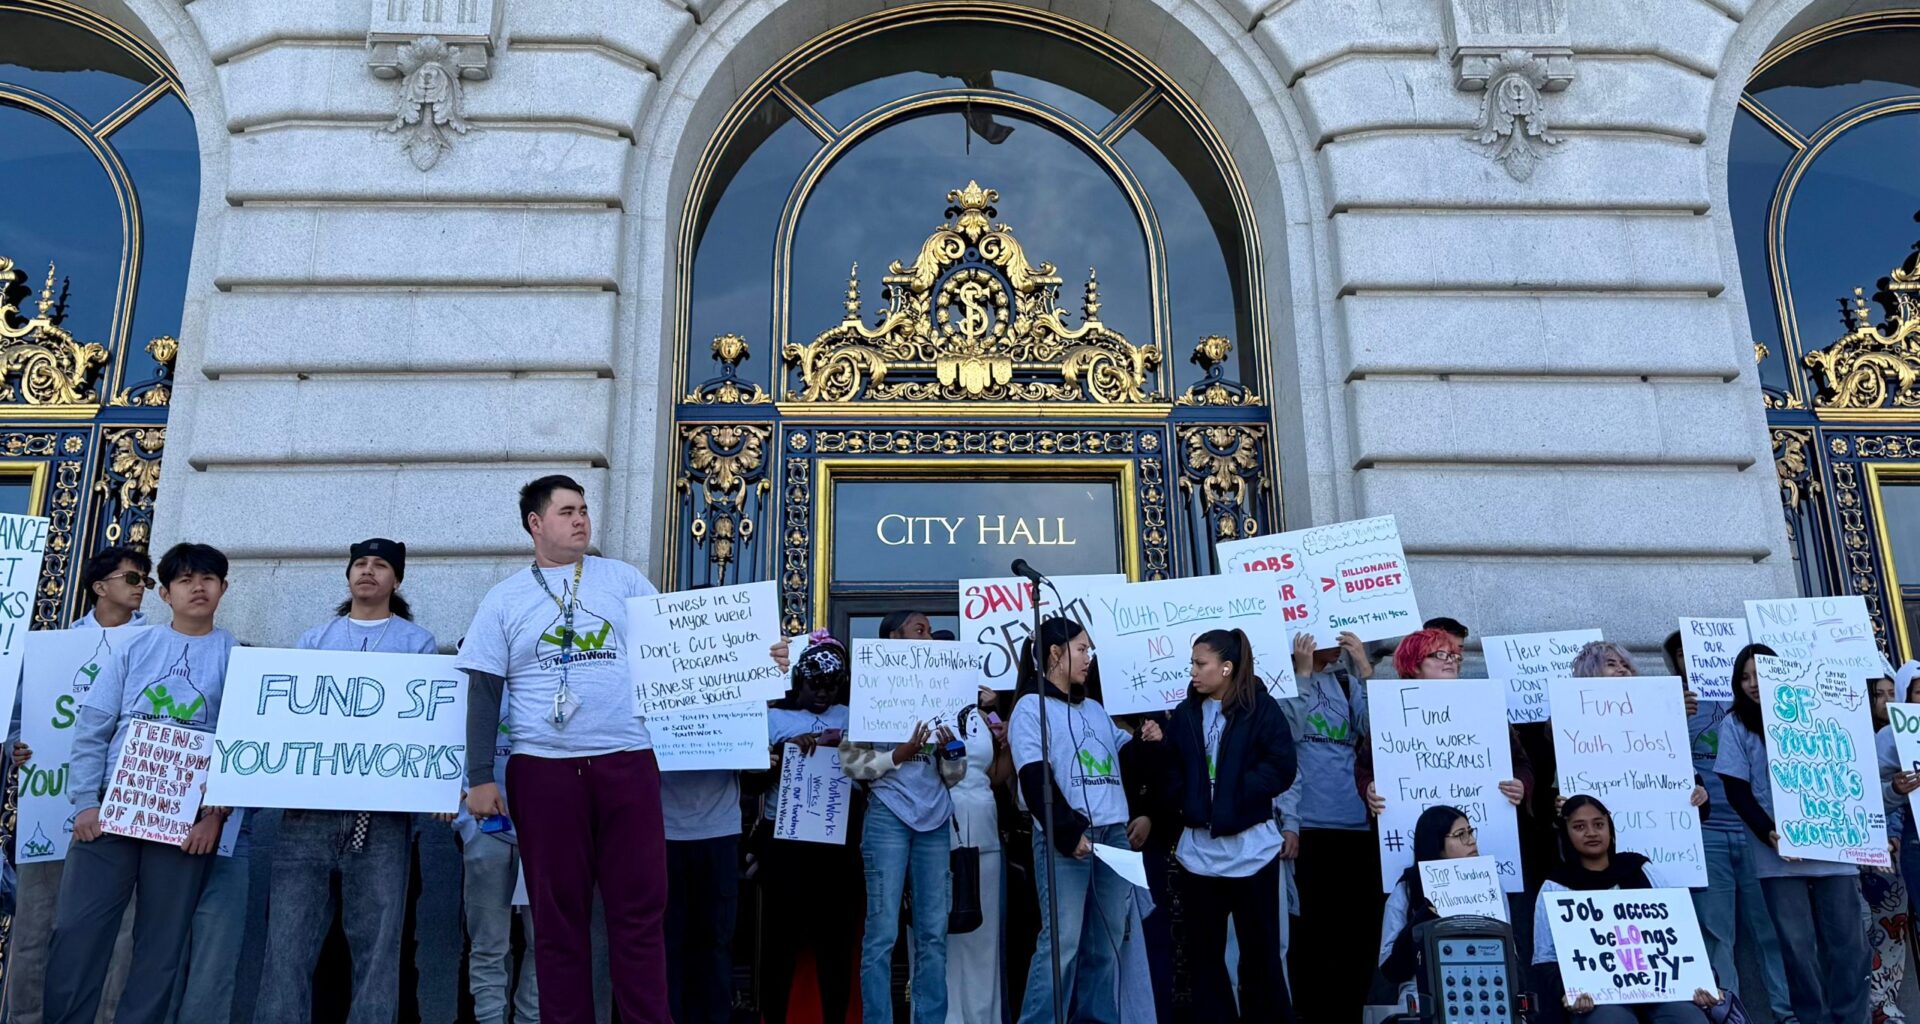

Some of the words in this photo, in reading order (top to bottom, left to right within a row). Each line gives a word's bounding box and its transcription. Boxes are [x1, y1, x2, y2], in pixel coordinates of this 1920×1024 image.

[876, 513, 965, 546] CITY
[977, 514, 1077, 545] HALL
[1341, 561, 1399, 578] BILLIONAIRE
[1344, 573, 1402, 593] BUDGET
[1691, 620, 1736, 637] RESTORE
[1148, 635, 1174, 659] NO
[1703, 641, 1726, 653] OUR
[672, 651, 738, 673] PROGRAMS
[257, 674, 386, 717] FUND
[397, 679, 458, 722] SF
[1400, 686, 1451, 727] Fund
[1579, 689, 1633, 717] Fund
[1773, 684, 1821, 729] SF
[133, 720, 205, 750] TEENS
[1563, 728, 1613, 755] Youth
[122, 754, 169, 778] HAVE
[175, 766, 194, 783] TO
[215, 739, 466, 780] YOUTHWORKS
[116, 769, 192, 797] PROTEST
[1398, 777, 1442, 801] Fund
[1450, 783, 1484, 799] their
[104, 804, 128, 821] OF
[109, 786, 181, 815] ACTIONS
[1800, 790, 1846, 820] has
[1665, 811, 1692, 831] TO
[1425, 864, 1450, 884] STOP
[1453, 864, 1492, 886] Funding
[1430, 890, 1488, 909] Billionaires
[1556, 897, 1604, 923] Job
[1613, 902, 1669, 920] access
